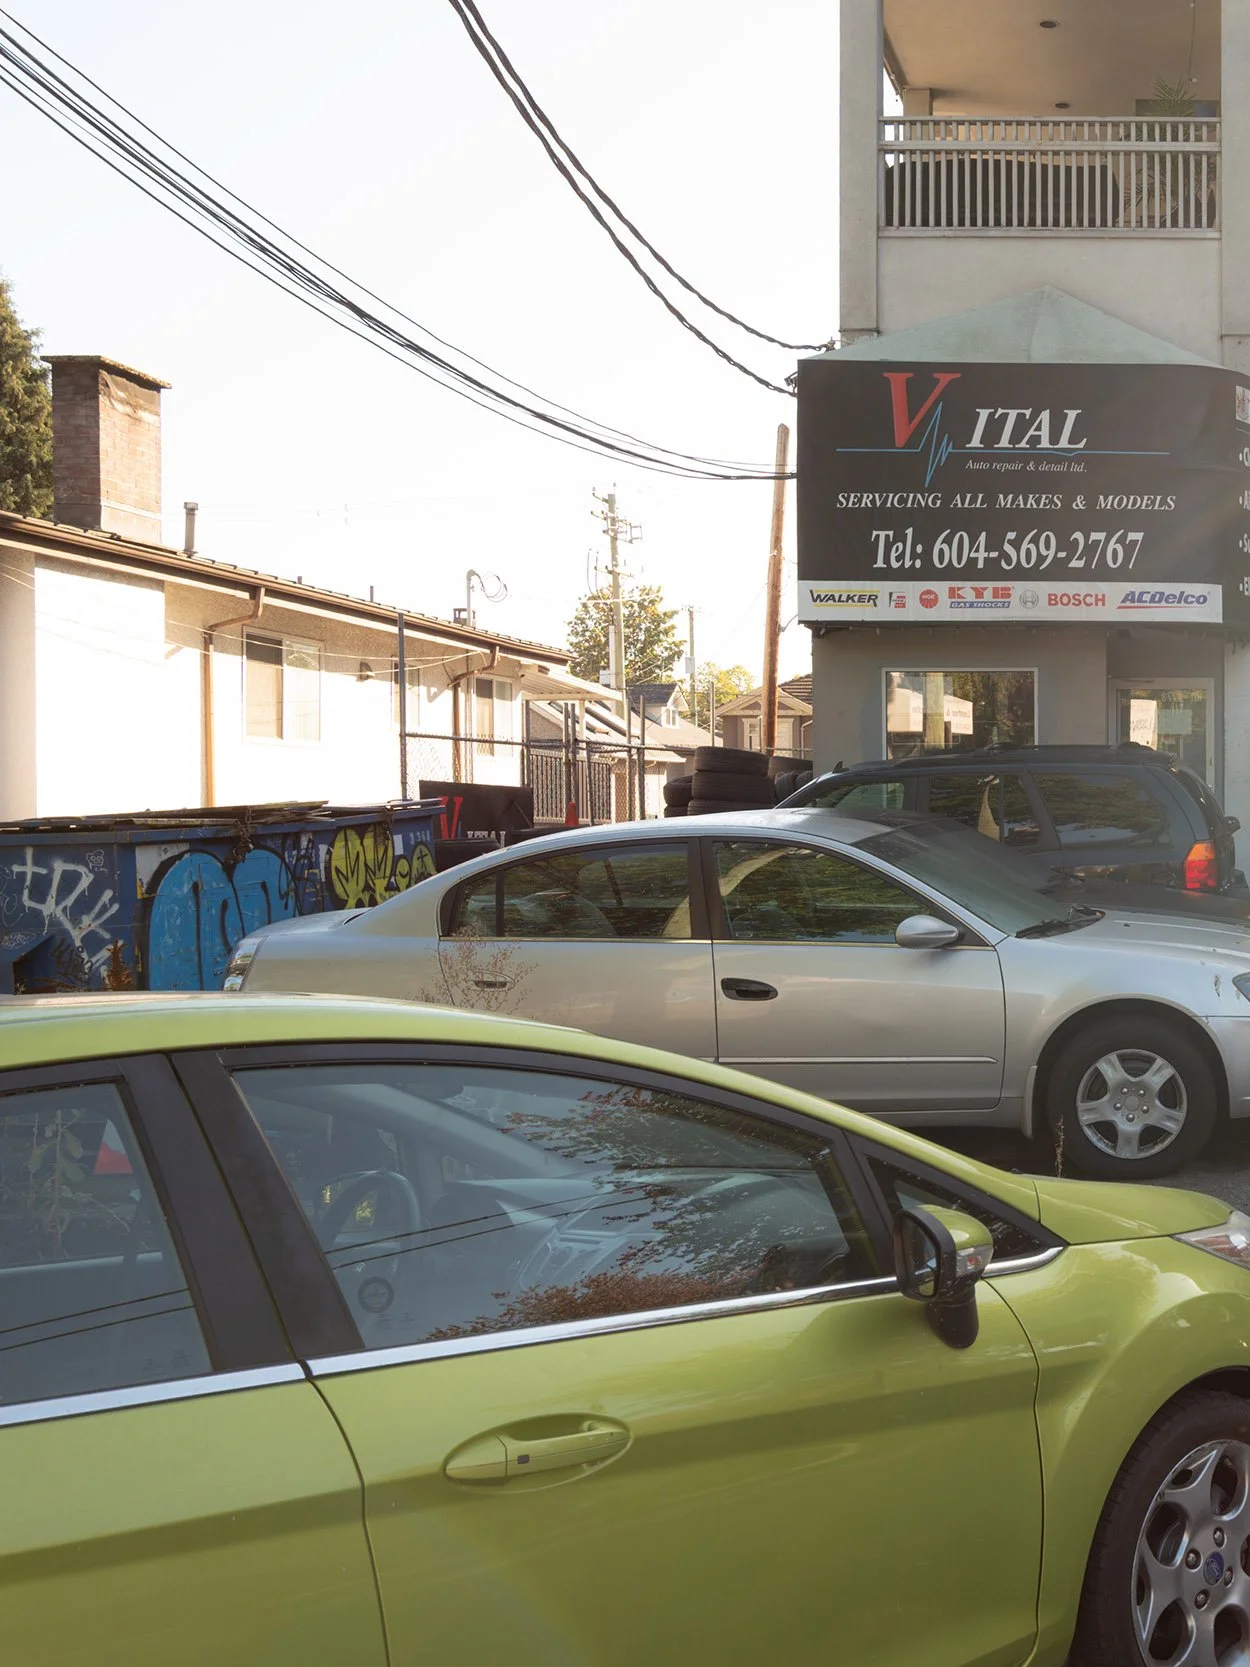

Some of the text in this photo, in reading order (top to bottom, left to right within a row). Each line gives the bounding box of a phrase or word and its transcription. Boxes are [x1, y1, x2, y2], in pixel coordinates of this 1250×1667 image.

[965, 459, 1088, 473] Auto repair & detail ltd.
[836, 492, 1176, 511] SERVICING ALL MAKES & MODELS
[871, 527, 1145, 571] Tel: 604-569-2767
[809, 589, 879, 607] WALKER
[948, 586, 1013, 600] KYB
[1048, 593, 1106, 607] BOSCH
[1121, 590, 1208, 605] ACDelco
[951, 601, 1011, 609] GAS SHOCKS
